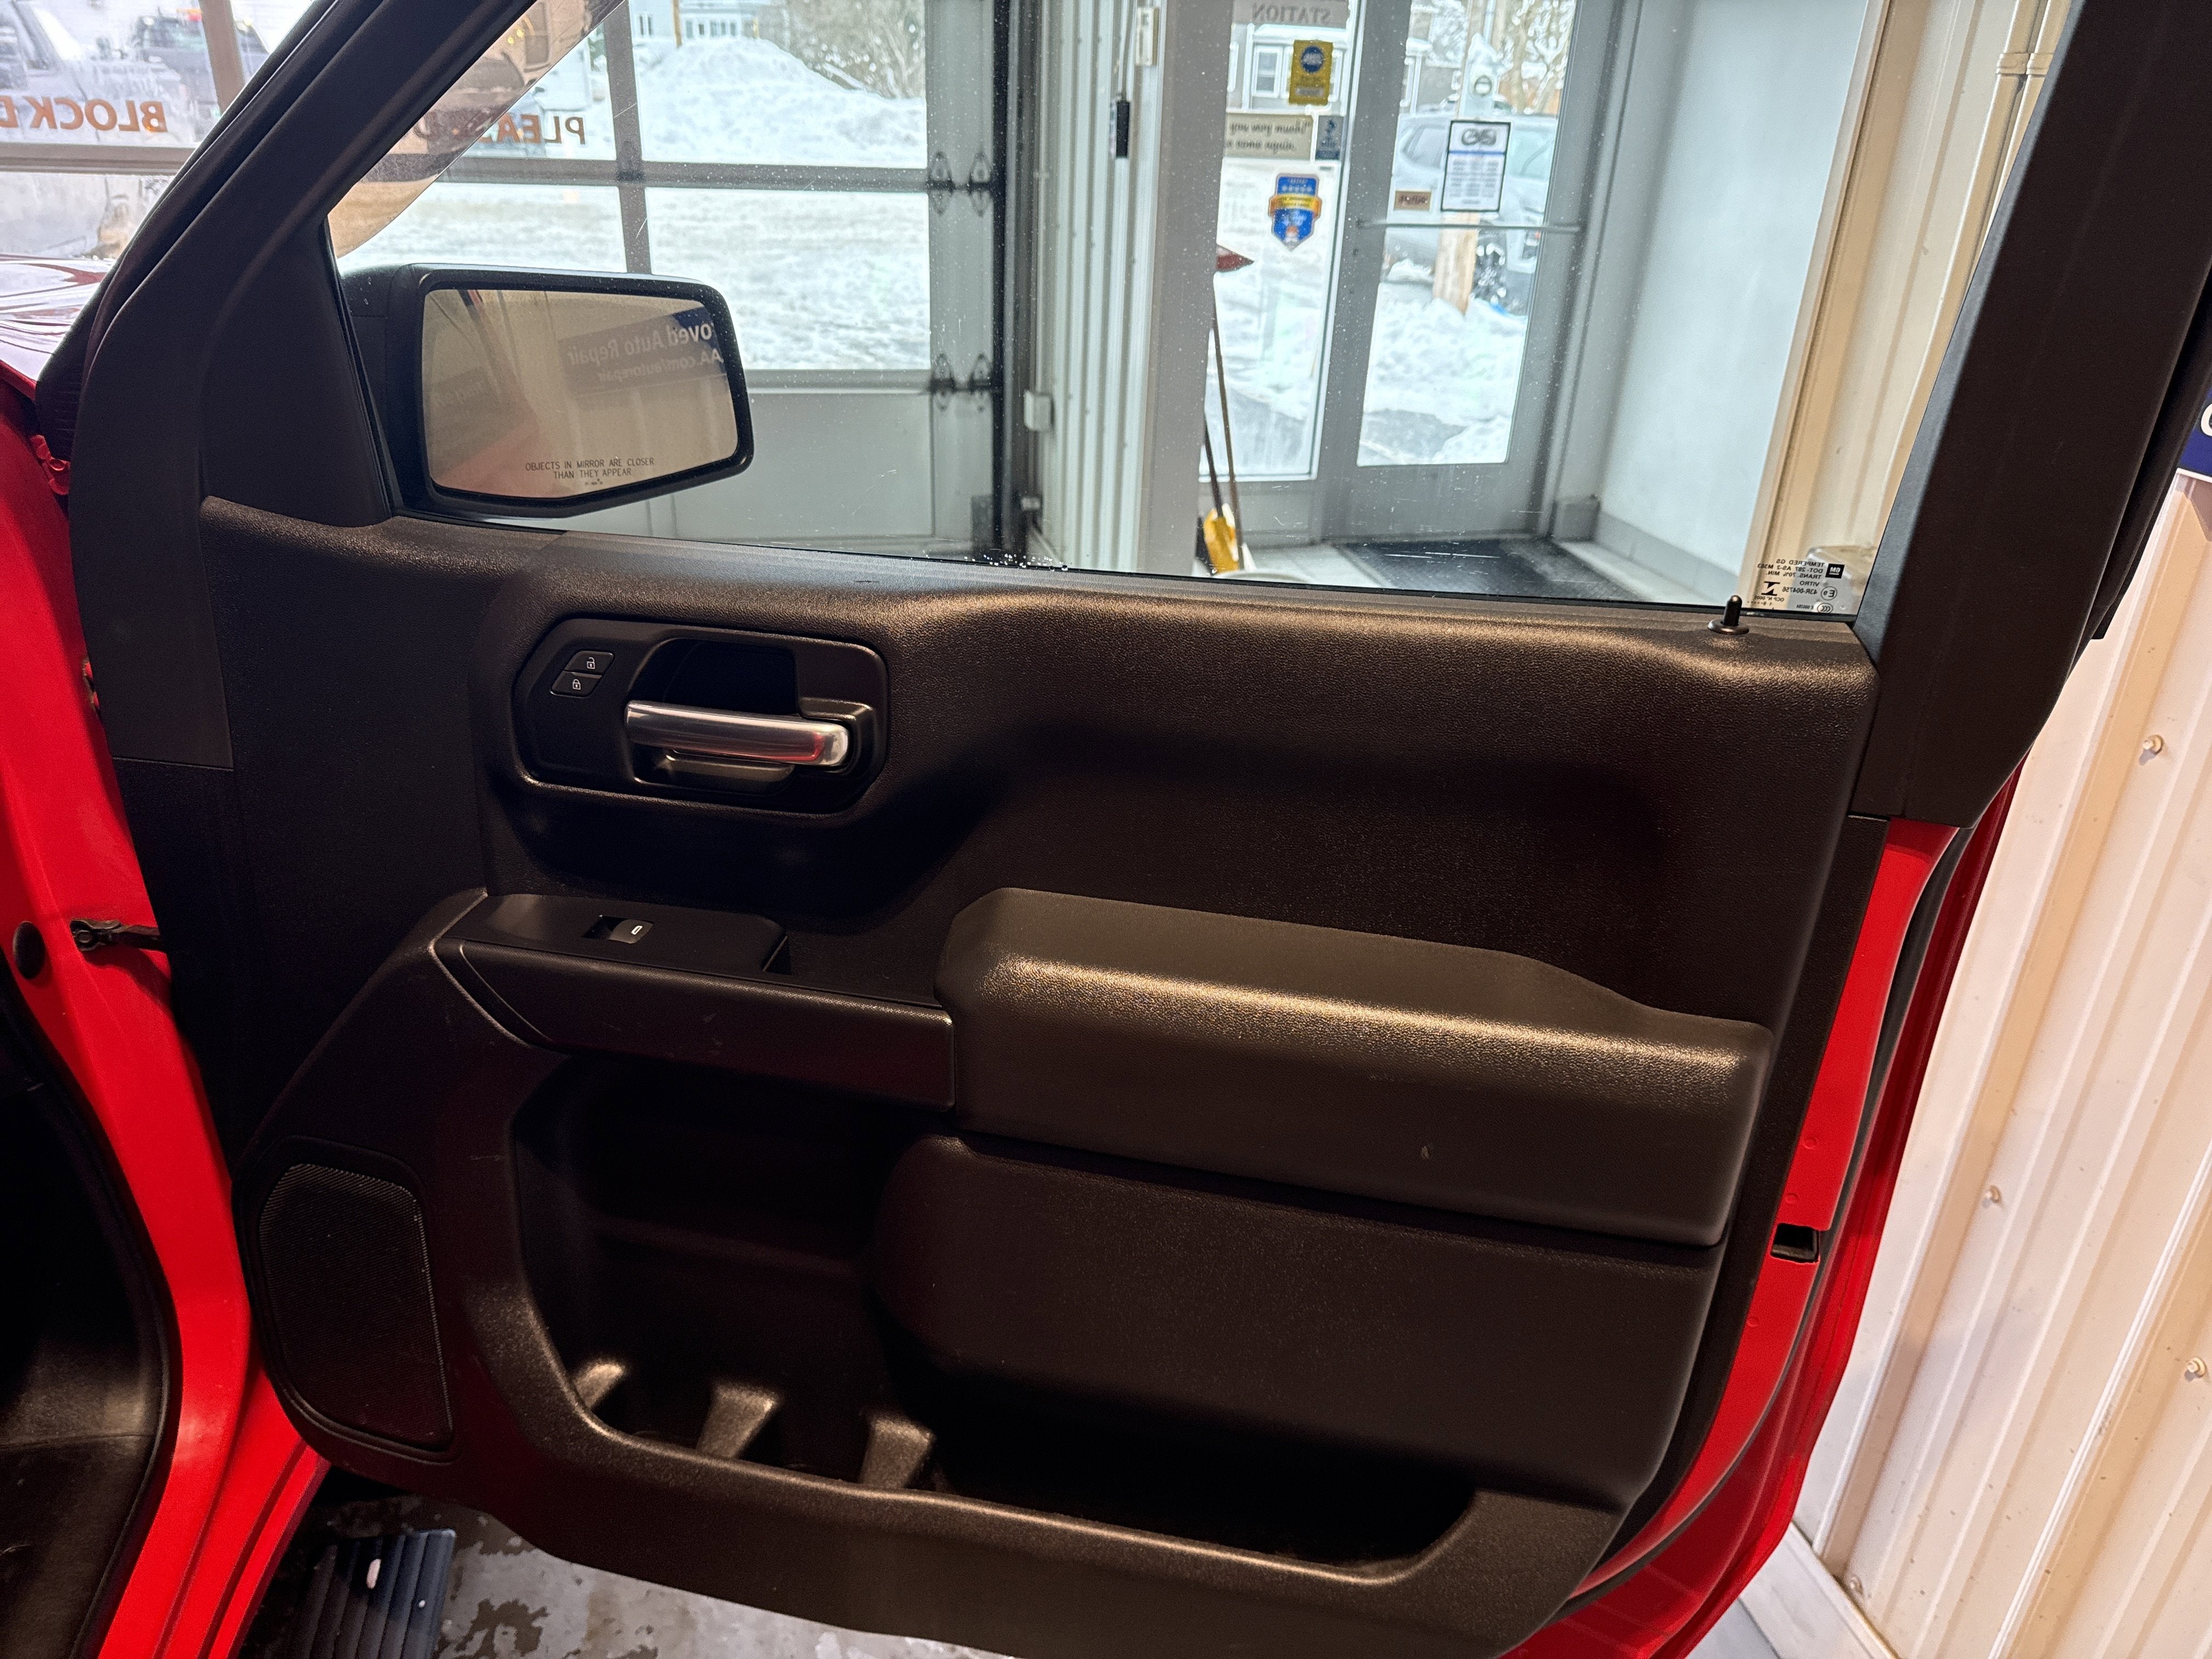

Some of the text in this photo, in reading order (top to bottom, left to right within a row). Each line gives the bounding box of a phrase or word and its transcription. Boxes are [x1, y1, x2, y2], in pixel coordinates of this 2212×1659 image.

[526, 458, 654, 471] OBJECTS IN MIRROR ARE CLOSER
[554, 468, 631, 479] THAN THEY APPEAR
